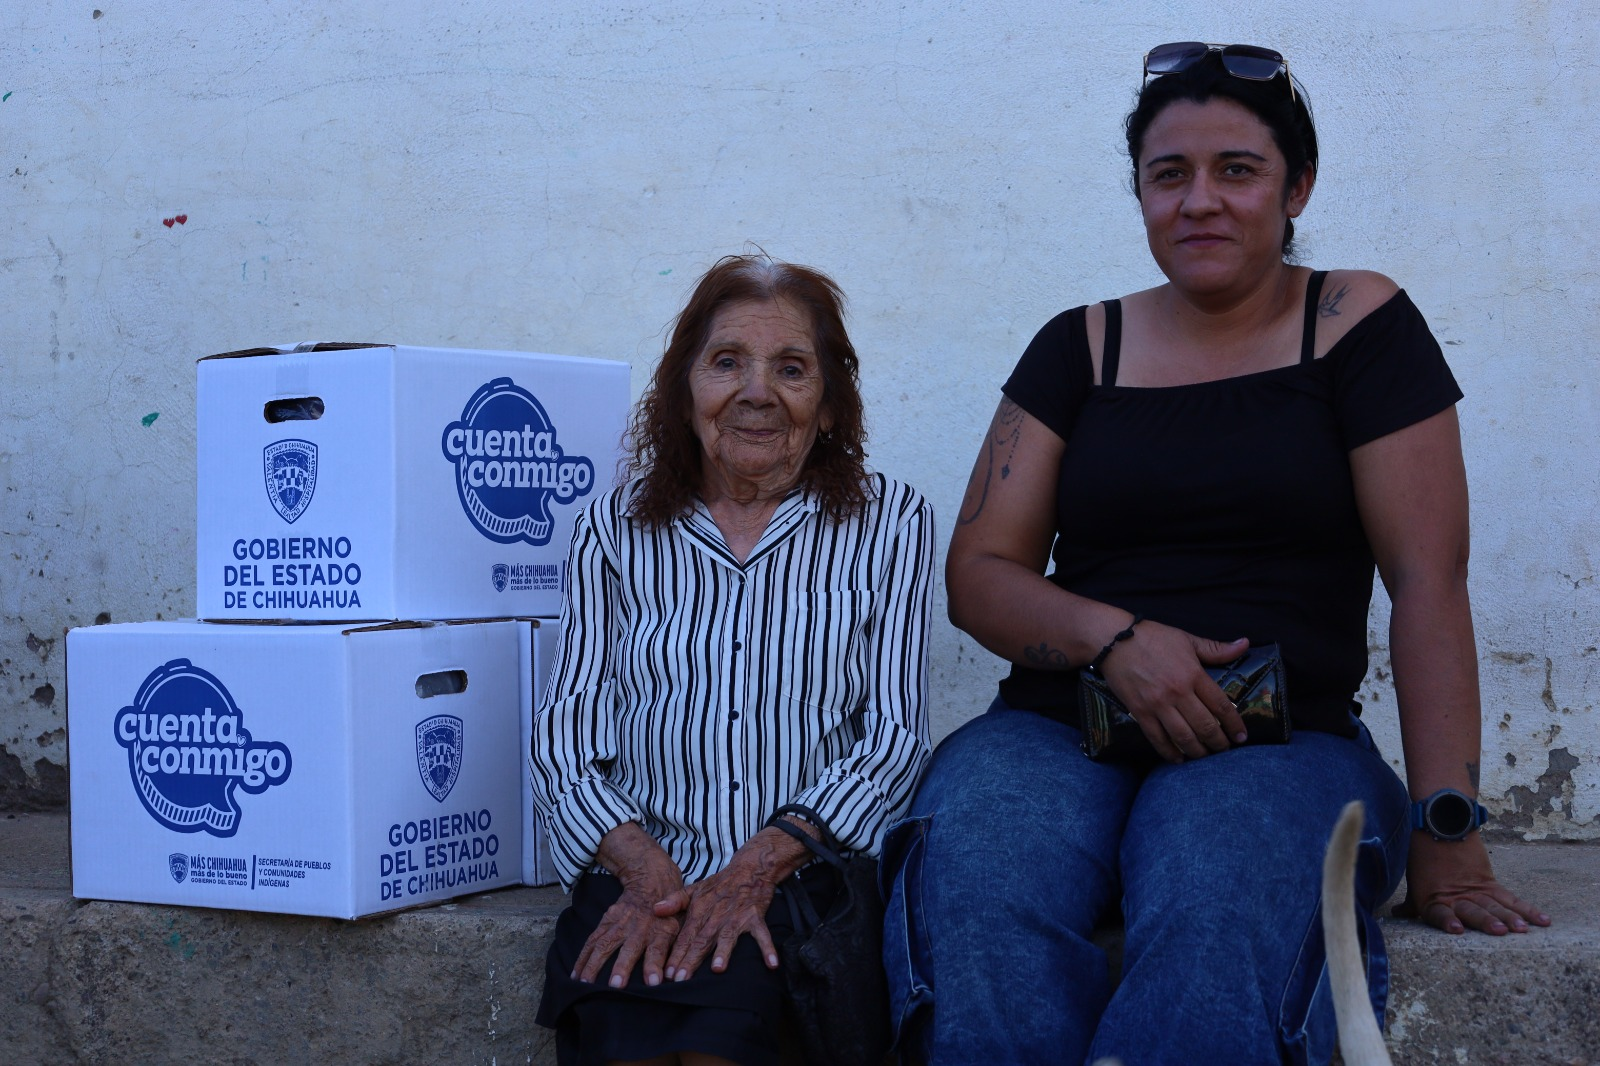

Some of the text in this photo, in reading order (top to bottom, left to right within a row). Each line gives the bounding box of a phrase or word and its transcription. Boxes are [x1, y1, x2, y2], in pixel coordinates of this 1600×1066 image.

[446, 424, 553, 458] cuenta
[467, 460, 591, 498] conmigo
[233, 536, 352, 560] GOBIERNO
[224, 563, 361, 586] DEL ESTADO
[510, 563, 558, 577] MÁS CHIHUAHUA
[224, 590, 361, 608] DE CHIHUAHUA
[118, 707, 238, 744] cuenta
[141, 745, 287, 787] conmigo
[388, 808, 492, 847] GOBIERNO
[190, 854, 247, 872] MÁS CHIHUAHUA
[258, 857, 331, 870] SECRETARÍA DE PUEBLOS
[380, 834, 499, 877] DEL ESTADO
[206, 870, 216, 878] de
[217, 870, 224, 878] lo
[226, 870, 248, 879] bueno
[258, 868, 306, 879] Y COMUNIDADES
[381, 860, 499, 901] DE CHIHUAHUA
